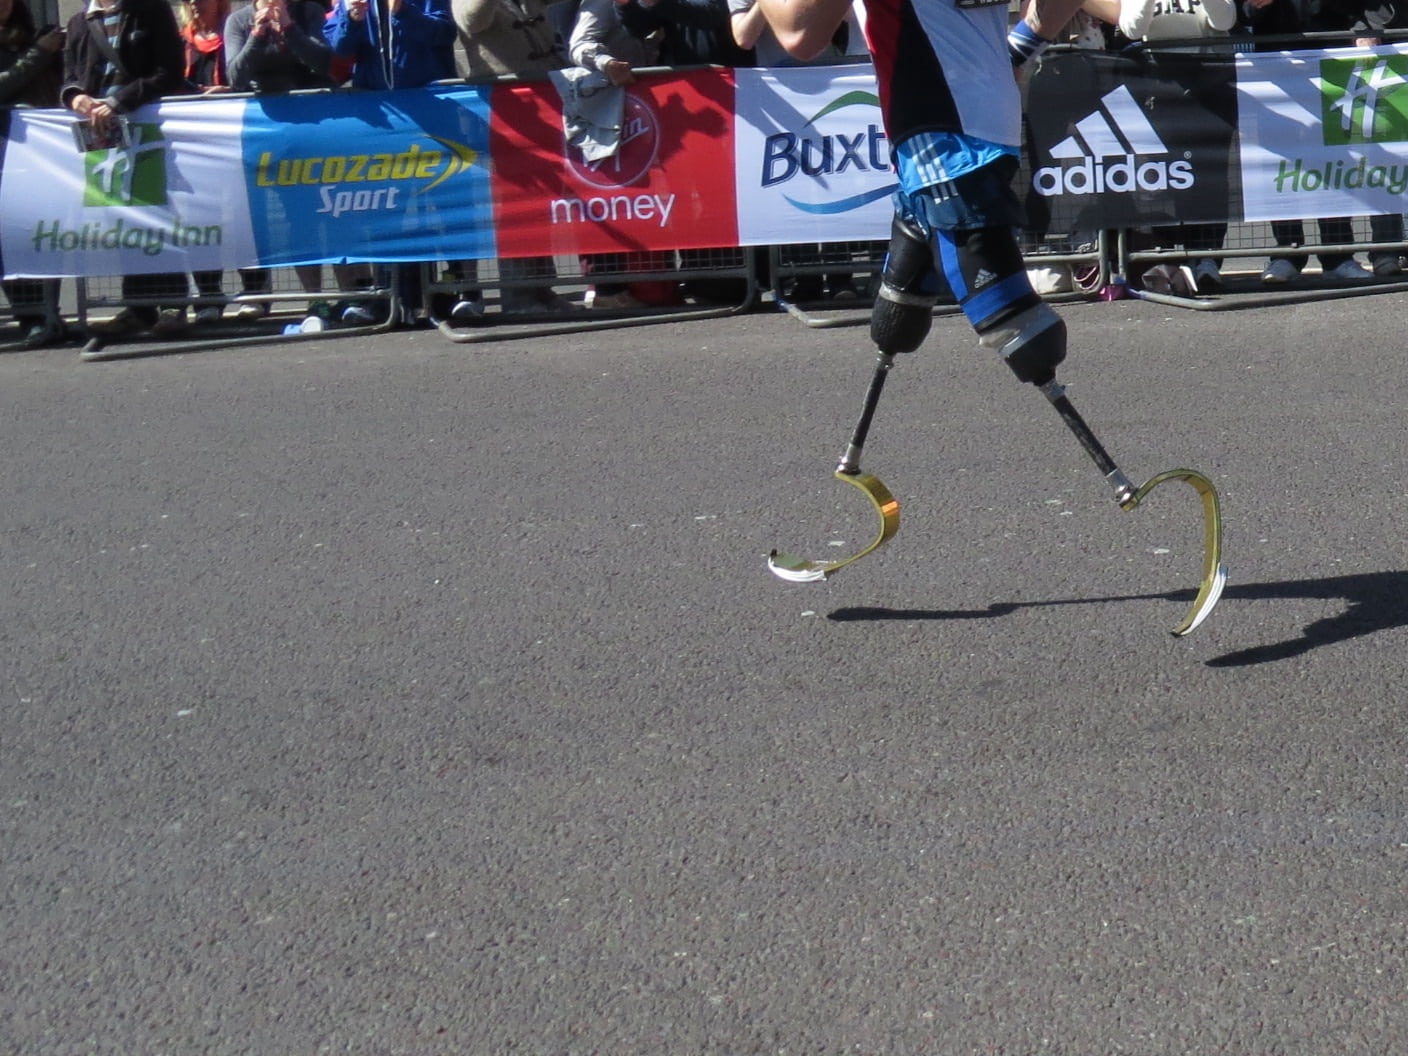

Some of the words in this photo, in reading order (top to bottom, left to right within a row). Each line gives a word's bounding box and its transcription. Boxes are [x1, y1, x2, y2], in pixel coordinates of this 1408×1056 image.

[255, 144, 441, 187] Lucozade
[761, 124, 890, 188] Buxt
[1032, 154, 1195, 196] adidas
[315, 185, 401, 217] Sport
[551, 193, 675, 226] money
[32, 217, 164, 256] Holiday
[171, 216, 222, 247] Inn
